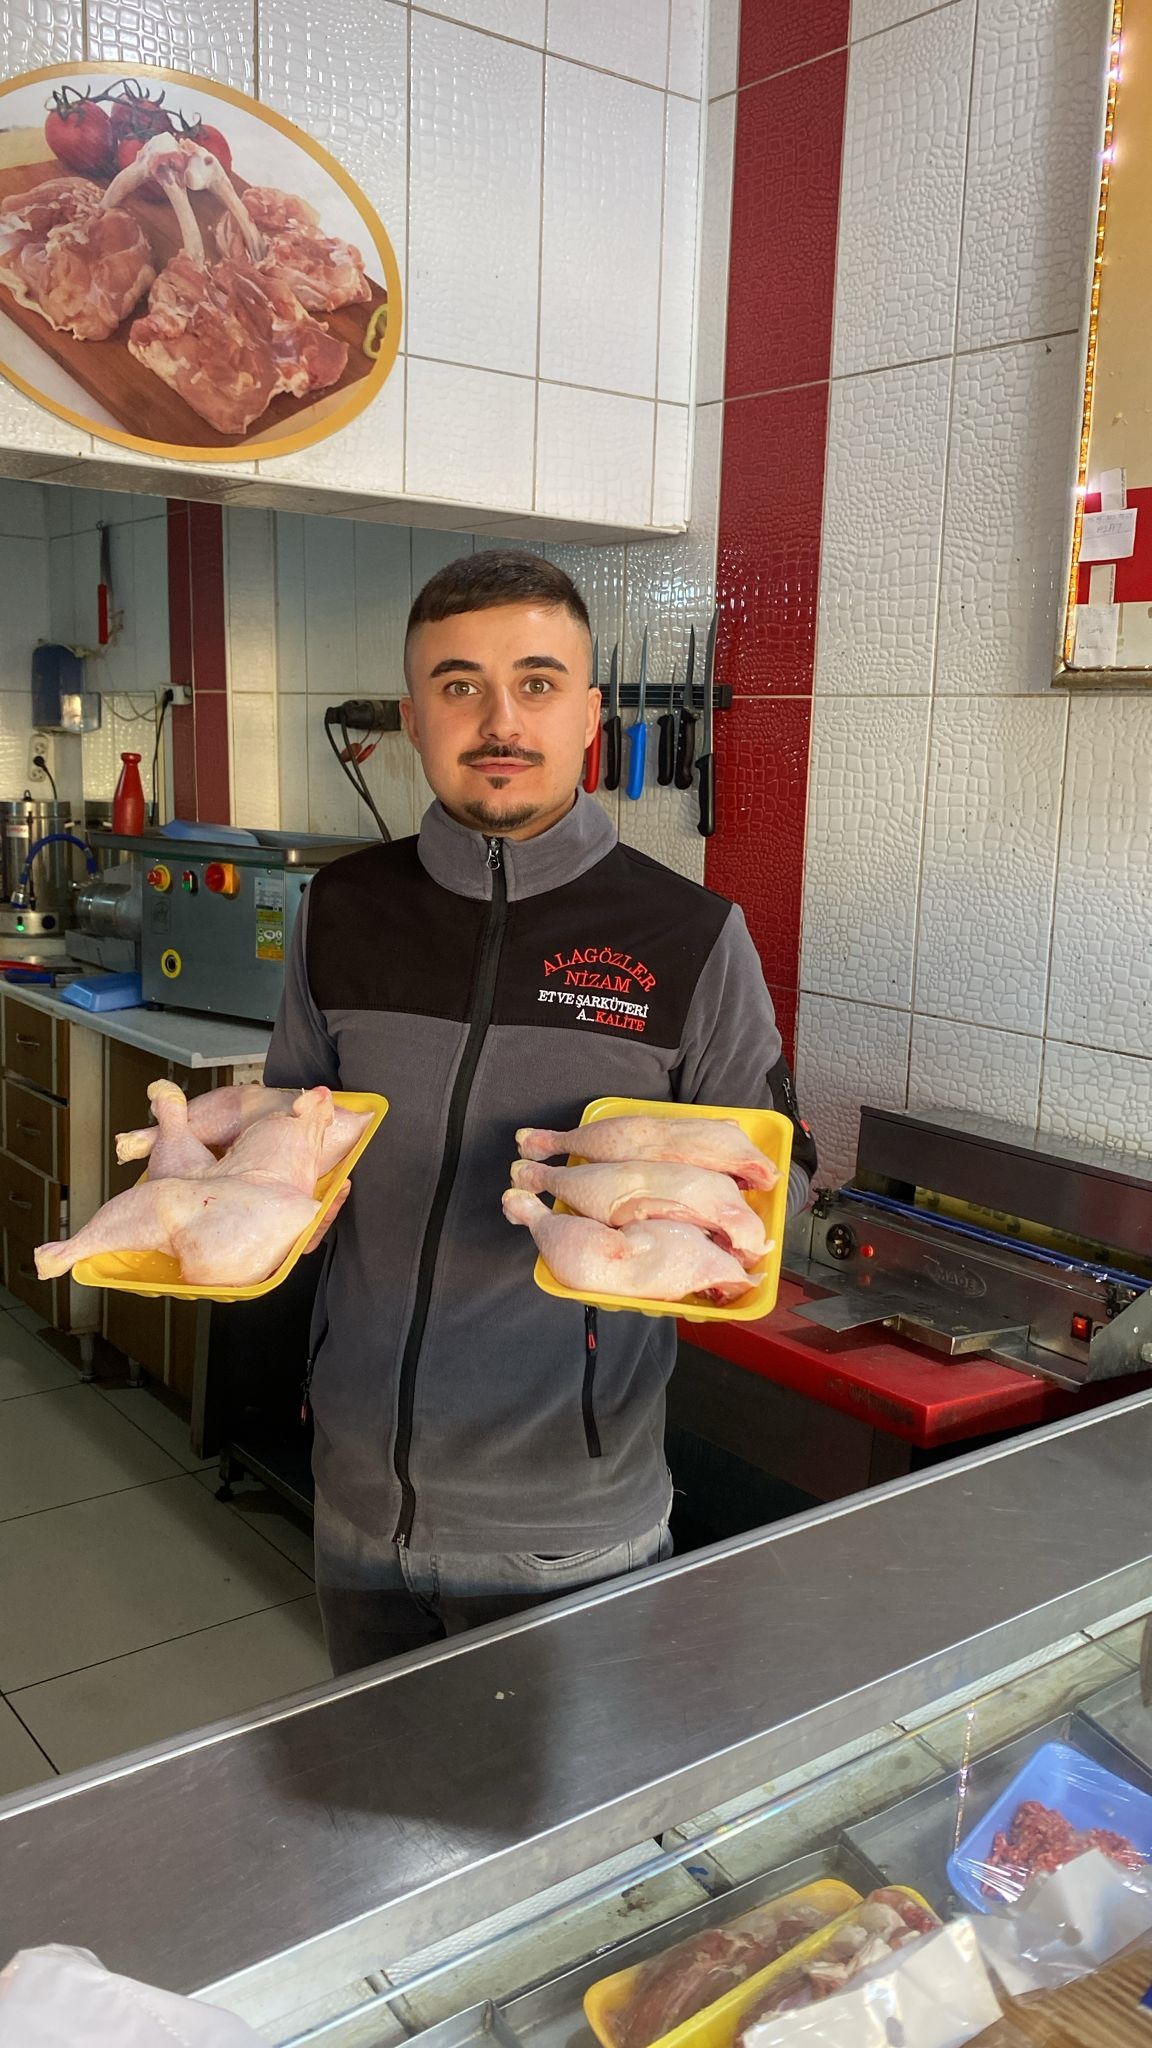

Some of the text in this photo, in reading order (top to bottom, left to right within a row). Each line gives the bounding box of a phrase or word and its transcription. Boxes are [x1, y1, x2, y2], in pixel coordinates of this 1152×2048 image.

[543, 947, 656, 992] ALAGÖZLER
[564, 969, 632, 993] NİZAM
[575, 994, 650, 1018] ŞARKÜTERİ
